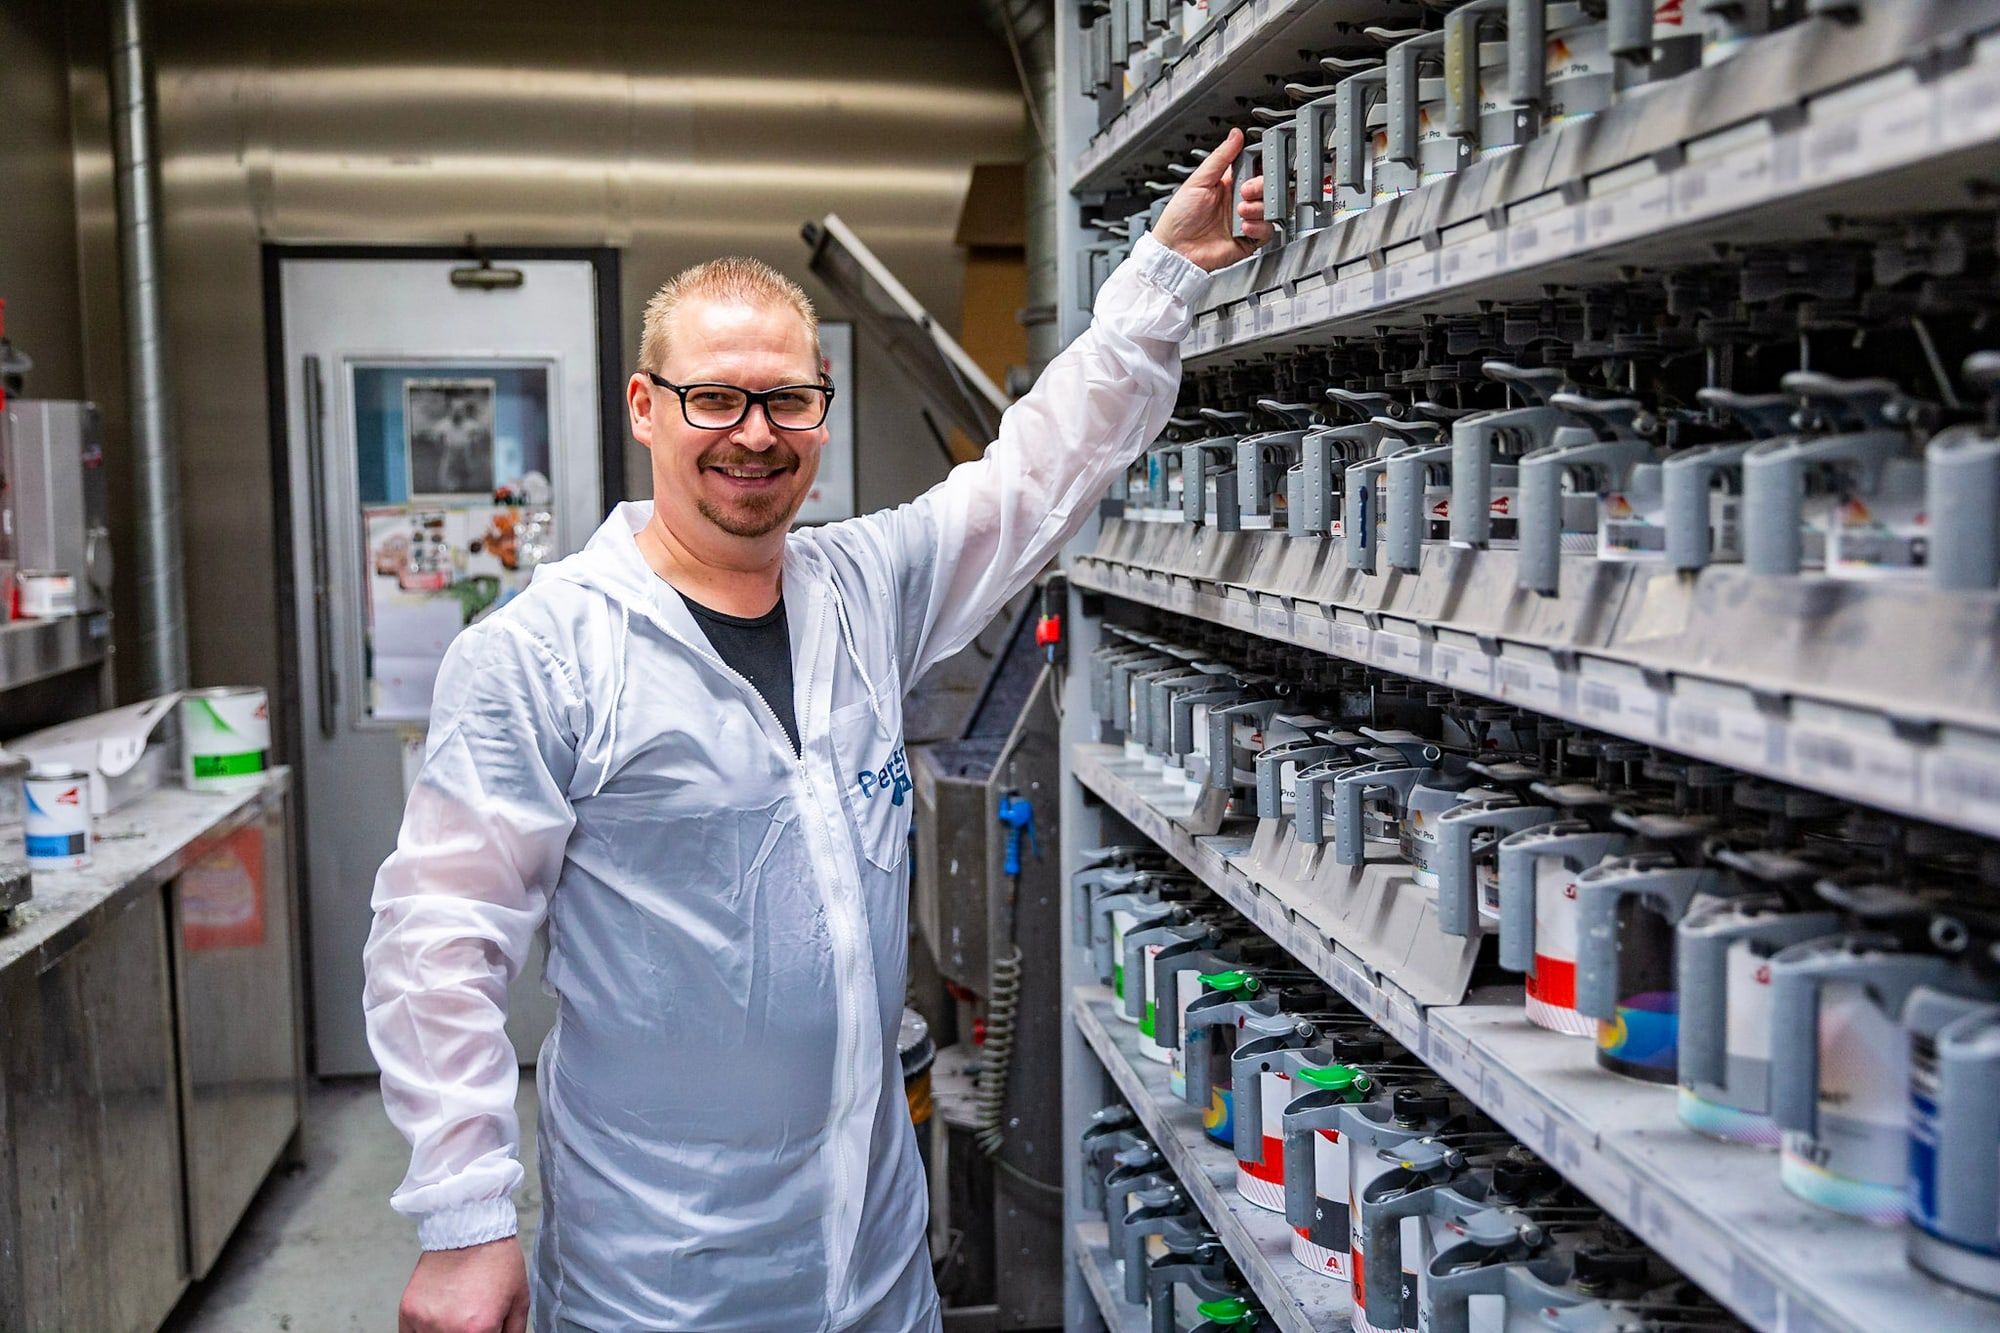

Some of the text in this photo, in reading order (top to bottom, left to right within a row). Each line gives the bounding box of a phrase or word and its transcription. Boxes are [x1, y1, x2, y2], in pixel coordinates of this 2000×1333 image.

[1571, 64, 1589, 73] Pro
[1484, 102, 1496, 110] Pro
[1429, 130, 1440, 139] Pro
[1280, 788, 1296, 798] Pro
[1423, 831, 1434, 840] Pro
